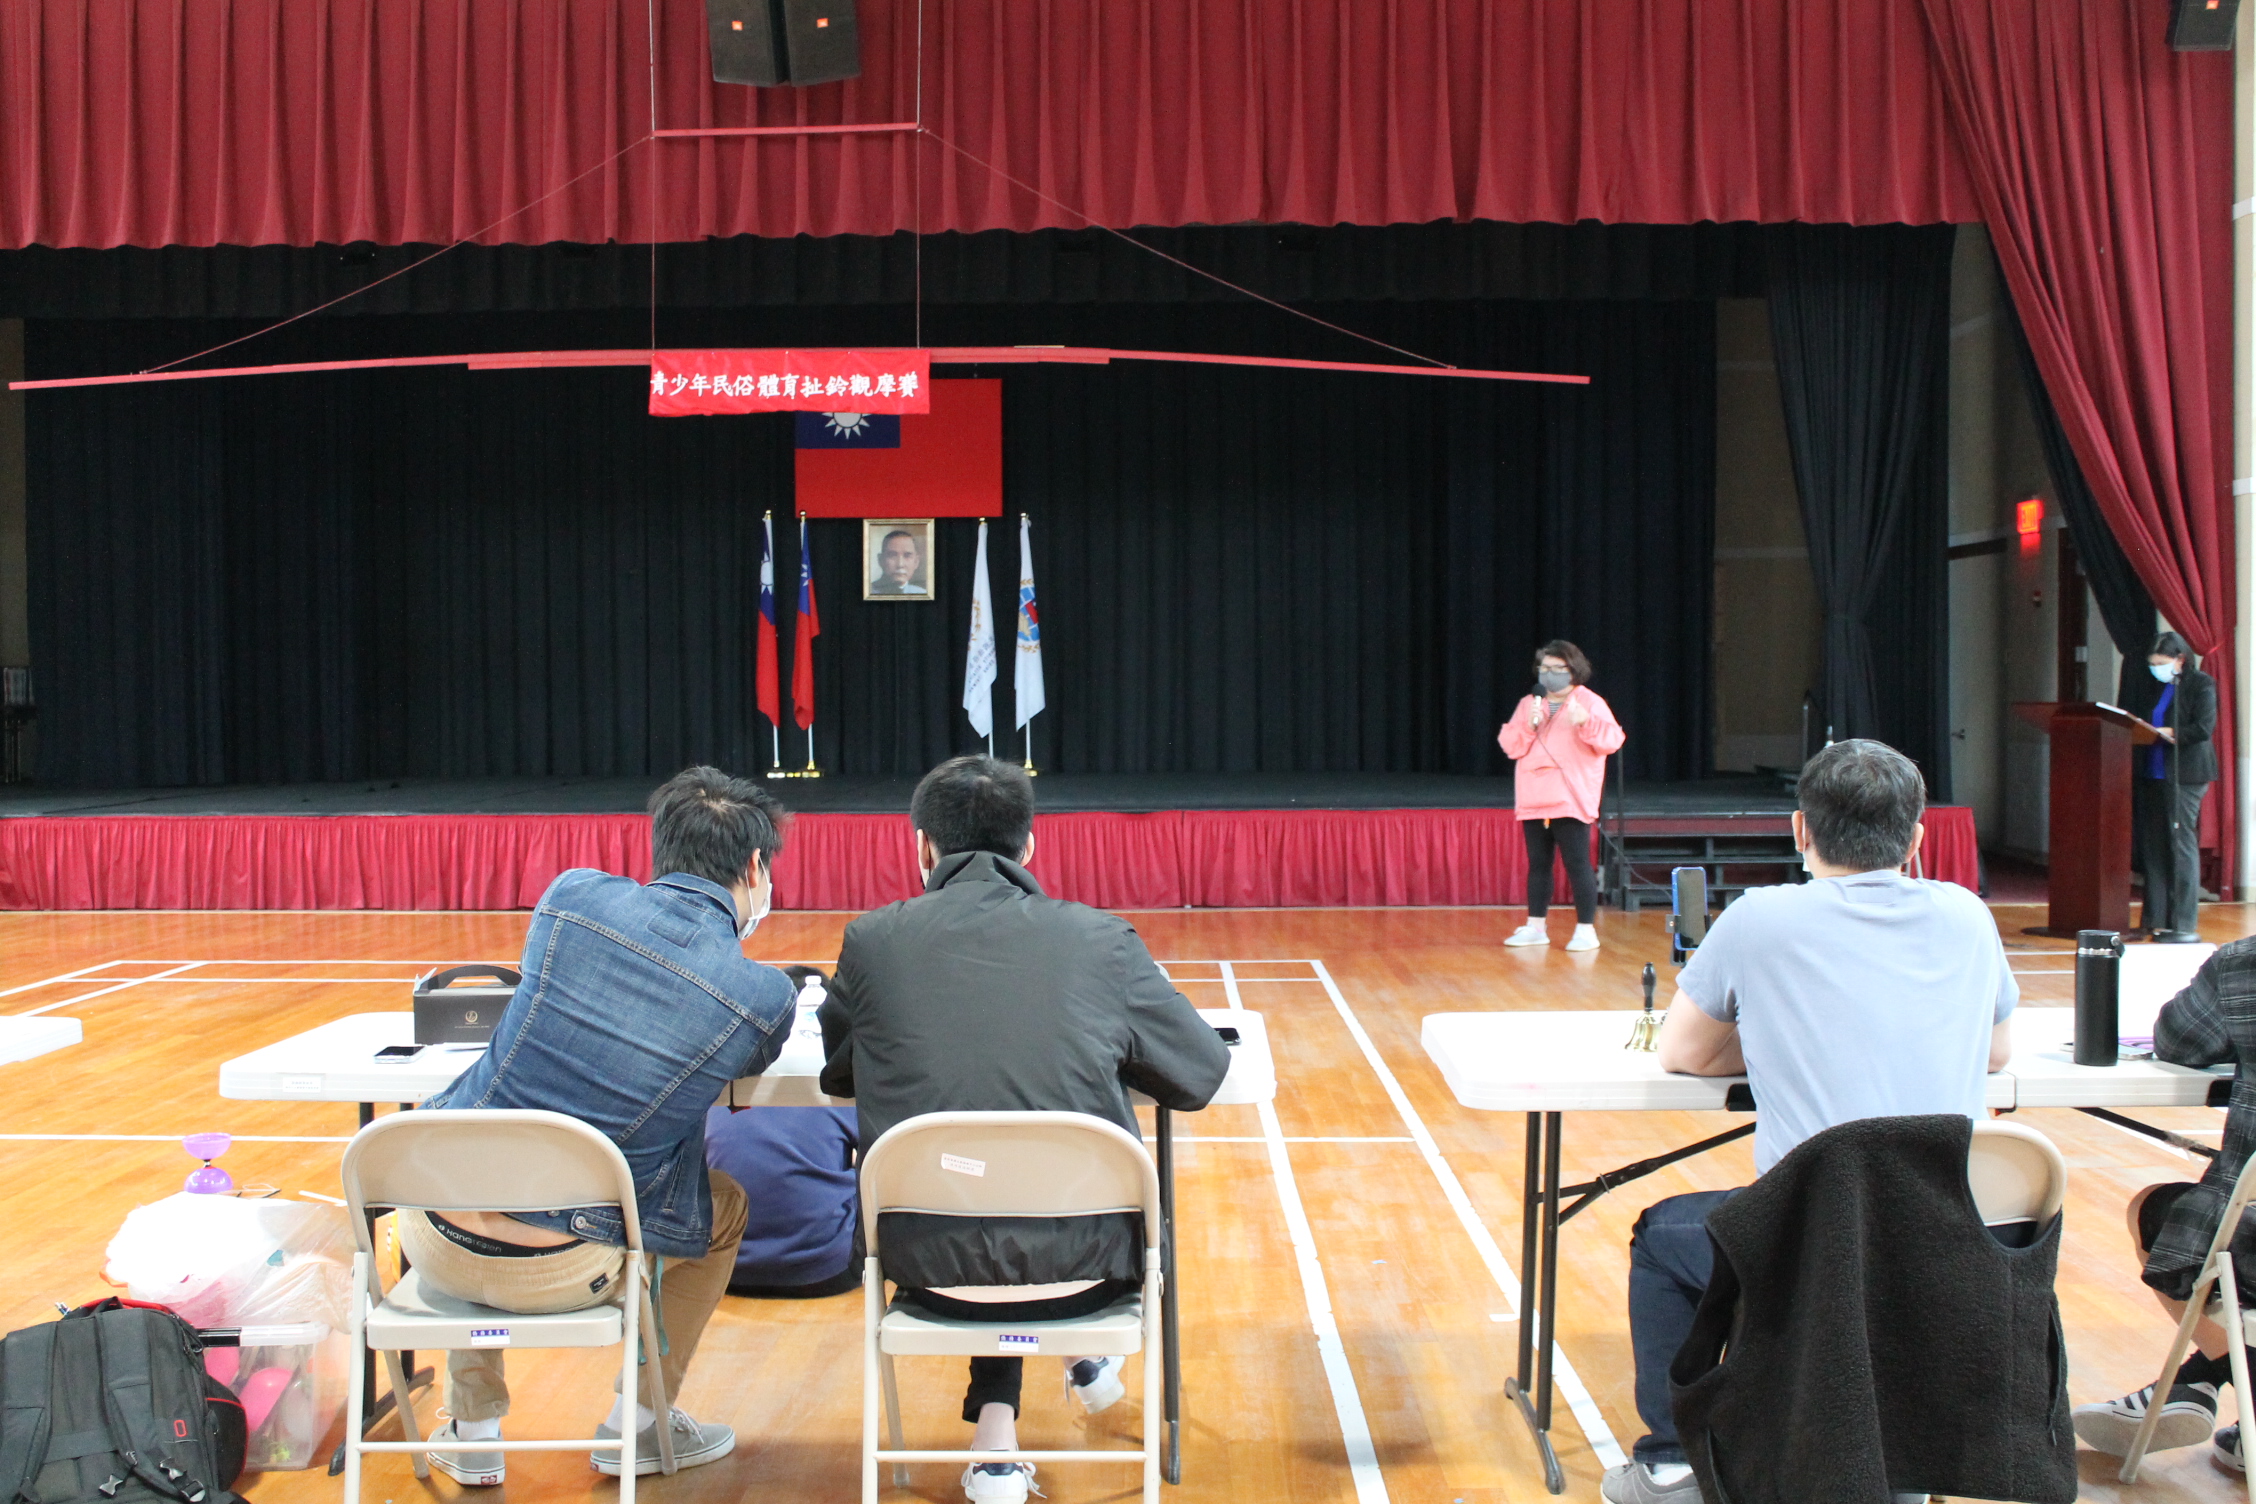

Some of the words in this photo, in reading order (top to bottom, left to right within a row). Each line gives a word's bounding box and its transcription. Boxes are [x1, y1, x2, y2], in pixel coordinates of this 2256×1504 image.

[650, 370, 919, 399] 青少年民俗體育扯鈴觀摩賽
